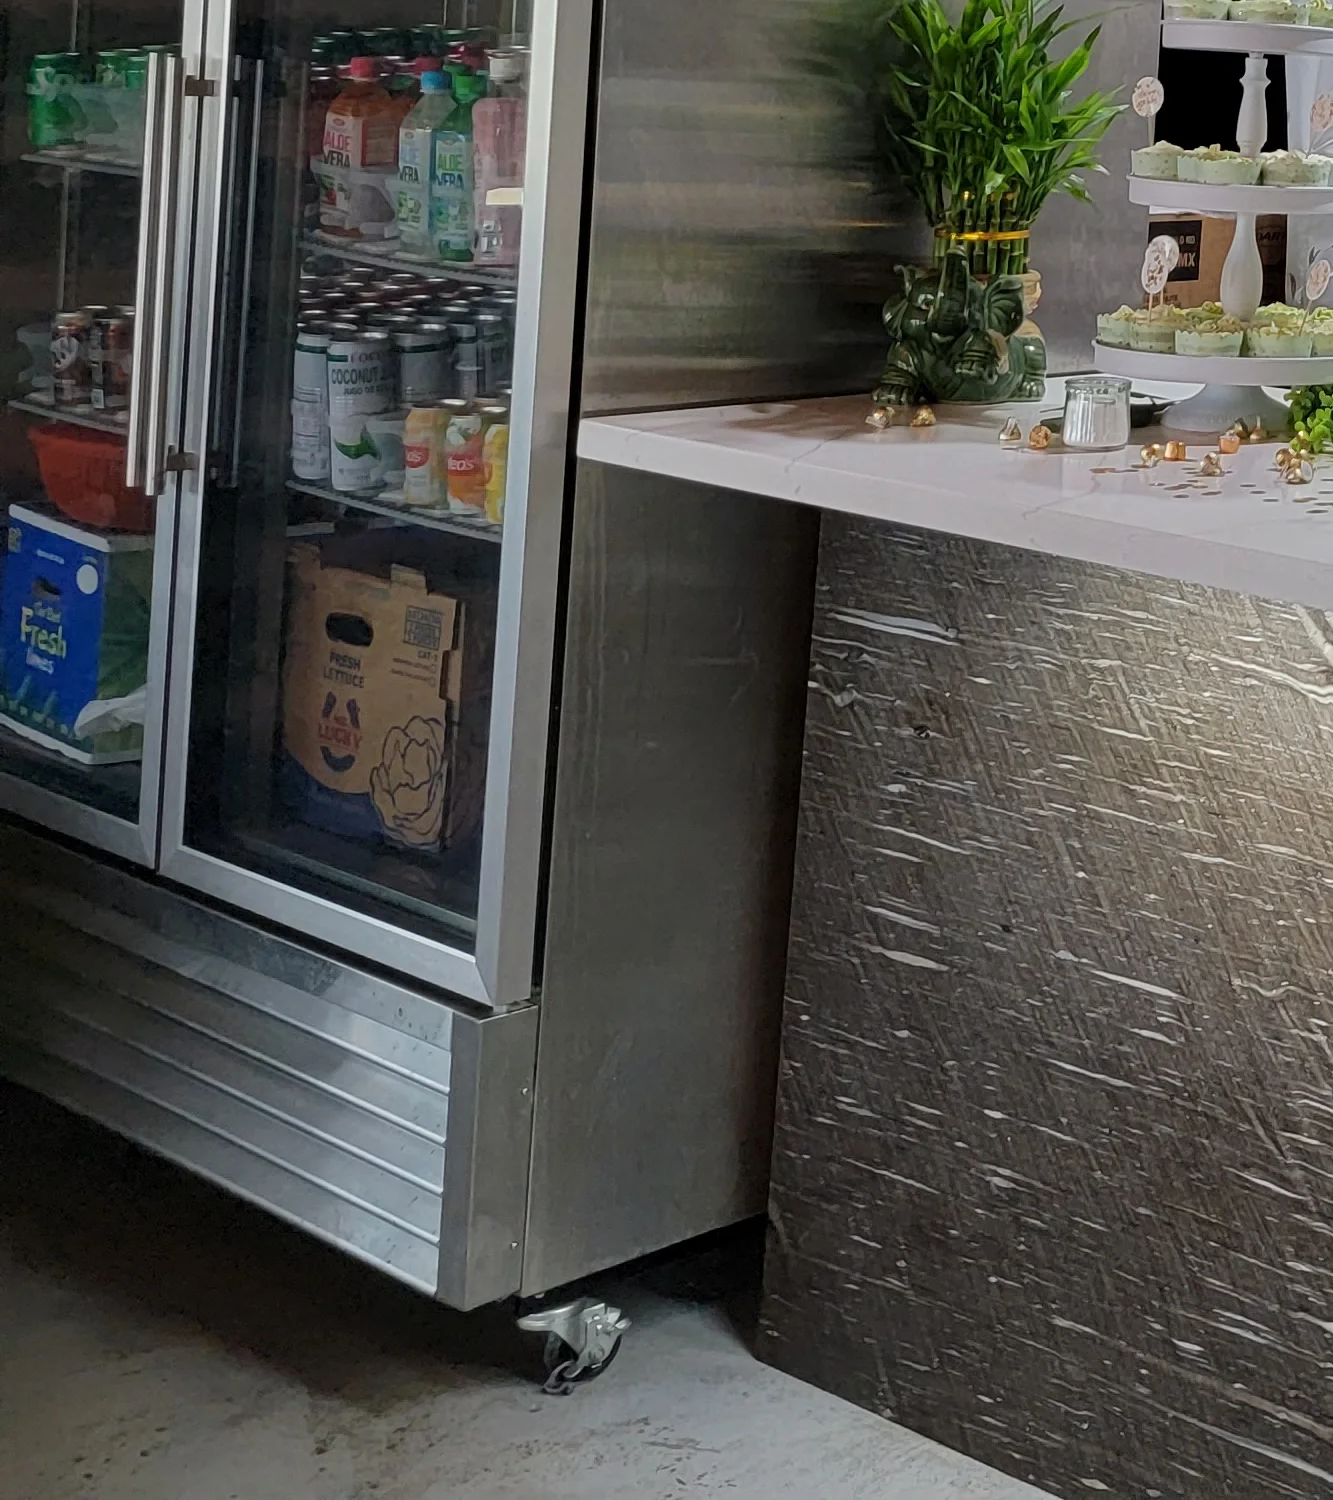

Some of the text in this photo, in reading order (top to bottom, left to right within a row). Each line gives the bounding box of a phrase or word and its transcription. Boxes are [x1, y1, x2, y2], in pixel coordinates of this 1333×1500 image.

[324, 131, 352, 152] ALOE
[323, 151, 352, 167] VERA
[437, 151, 465, 173] ALOE
[435, 172, 466, 190] VERA
[331, 366, 380, 385] COCONUT
[20, 605, 67, 659] Fresh
[329, 651, 361, 670] FRESH
[323, 666, 365, 689] LETTUCE
